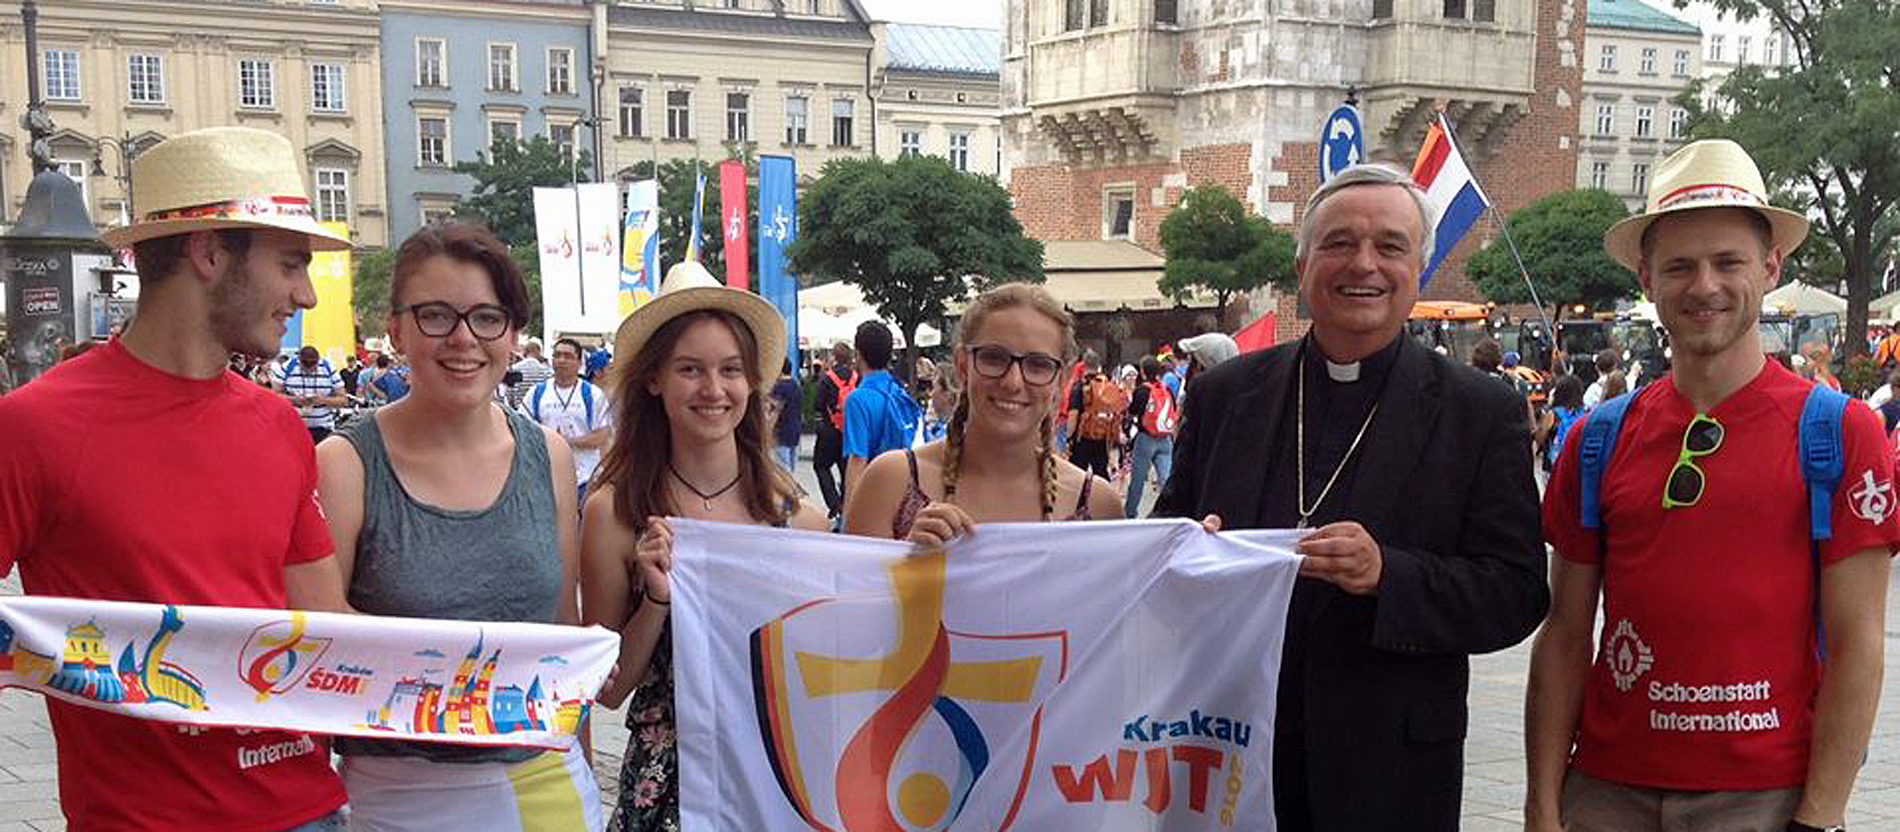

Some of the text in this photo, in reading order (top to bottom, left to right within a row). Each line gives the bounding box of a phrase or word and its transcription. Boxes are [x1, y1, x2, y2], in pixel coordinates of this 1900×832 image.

[1648, 681, 1771, 702] Schoenstatt
[1124, 709, 1251, 747] Krakau
[1649, 708, 1780, 731] International
[1052, 745, 1243, 827] WJT 2016
